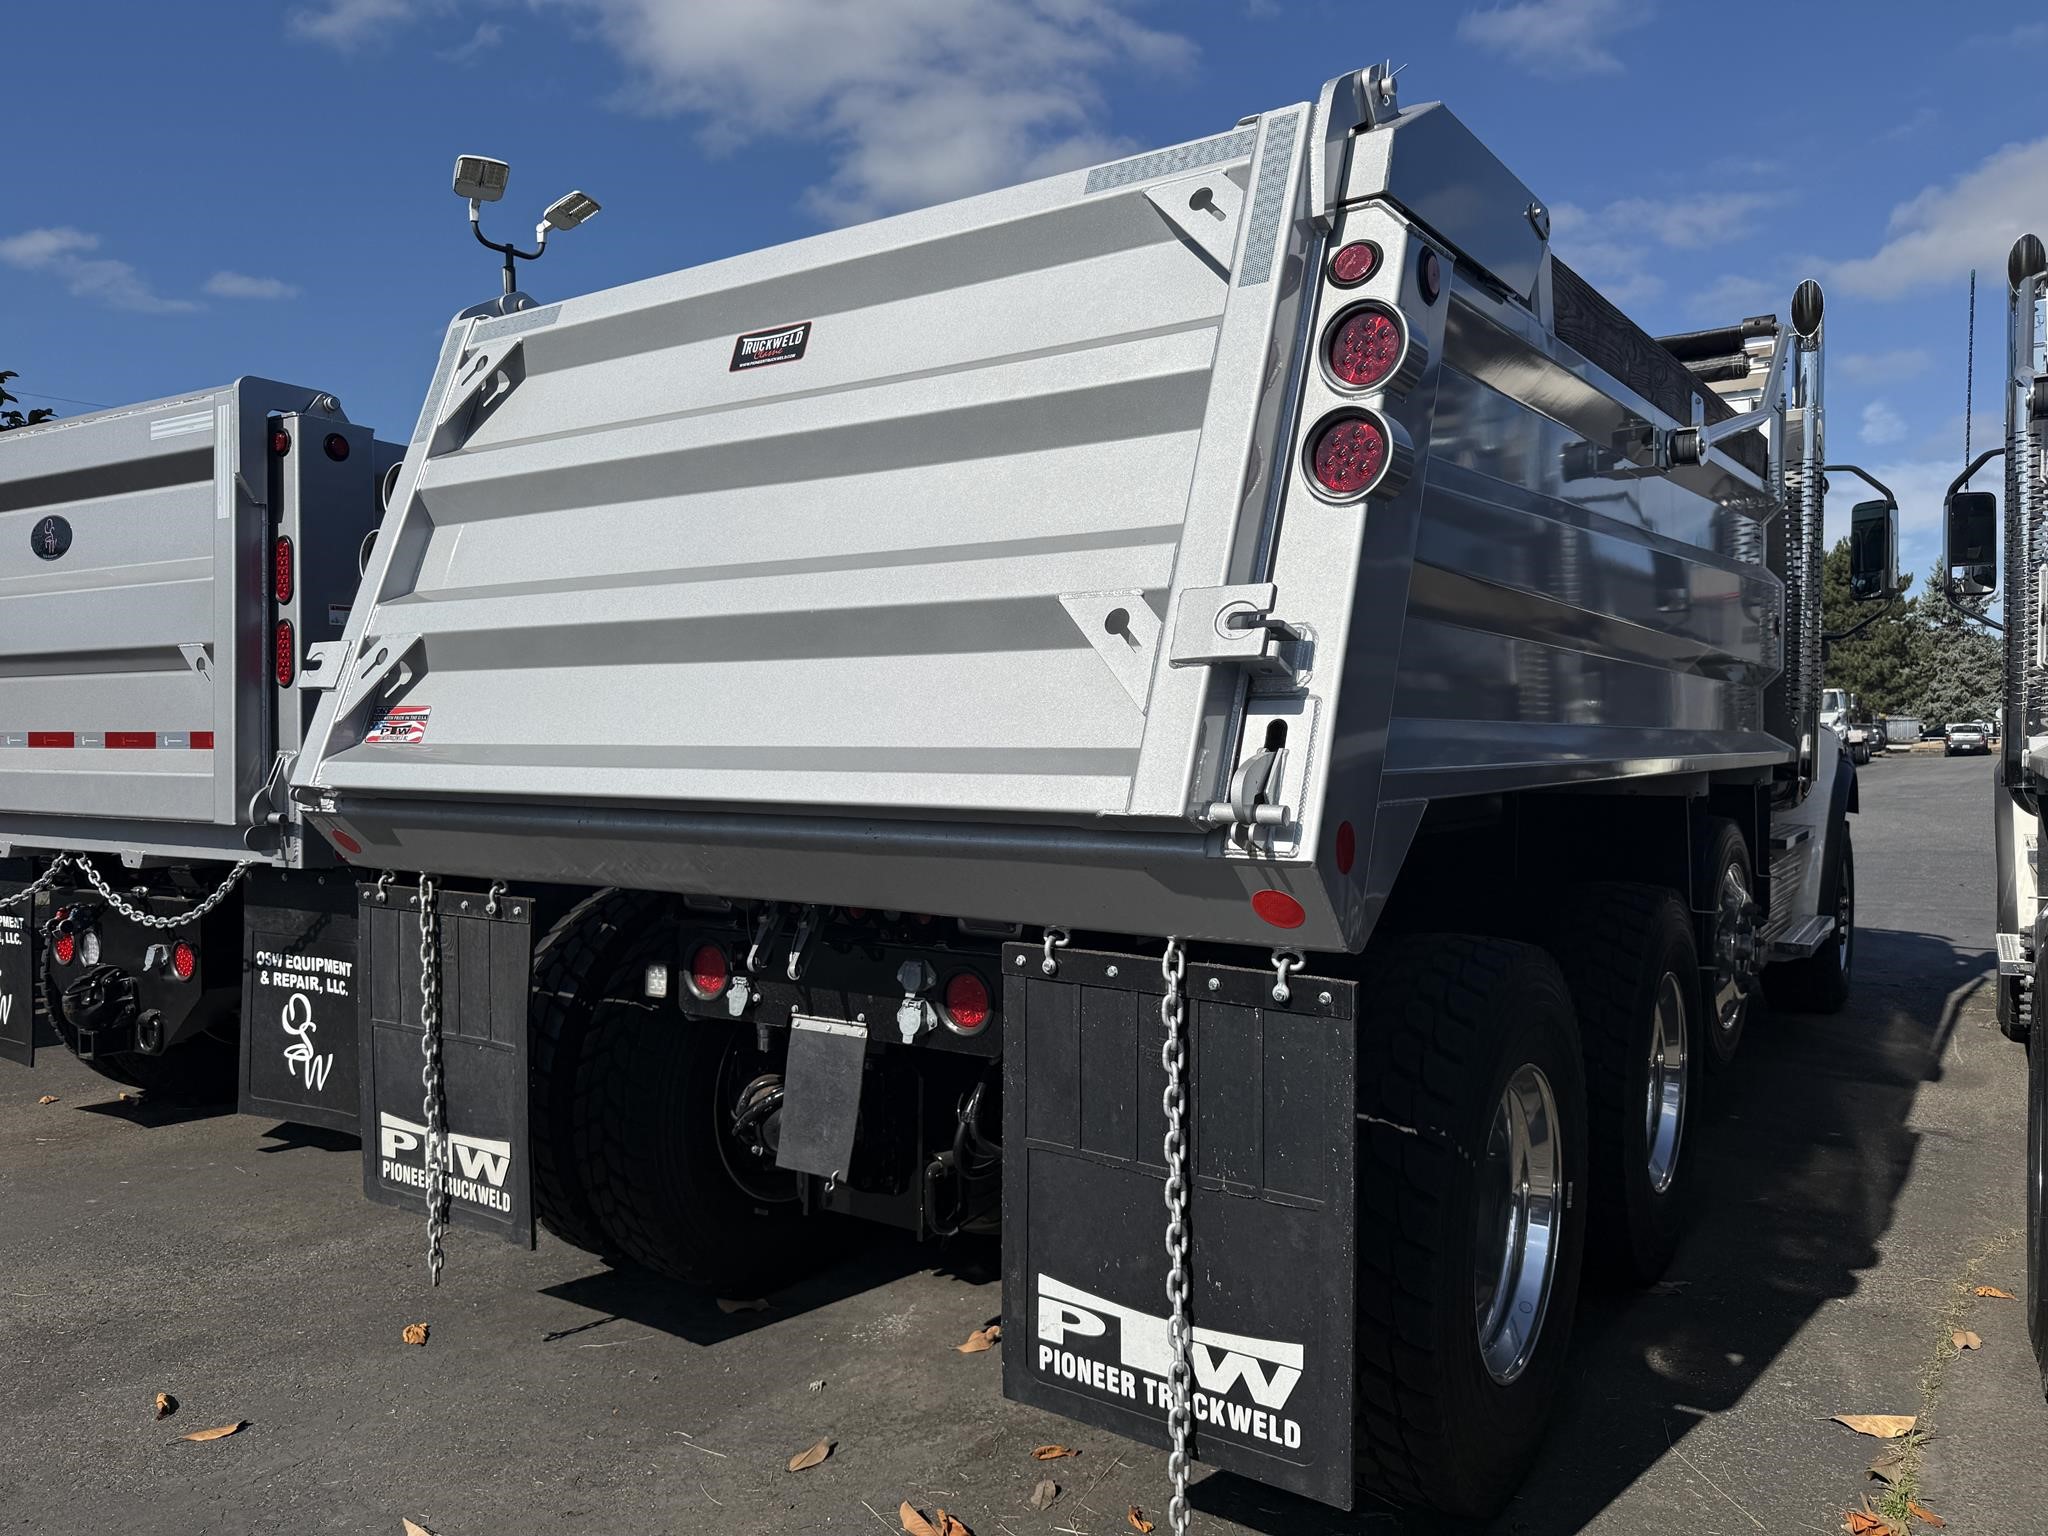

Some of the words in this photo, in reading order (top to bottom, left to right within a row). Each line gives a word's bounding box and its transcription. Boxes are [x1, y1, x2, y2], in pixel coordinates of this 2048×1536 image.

[741, 326, 805, 356] TRUCKWELD
[256, 951, 283, 968] OSW
[285, 954, 353, 978] EQUIPMENT
[260, 970, 270, 985] &
[273, 972, 323, 994] REPAIR,
[326, 978, 349, 997] LLC.
[1038, 1272, 1304, 1410] PTW
[1038, 1344, 1137, 1400] PIONEER
[1142, 1377, 1302, 1449] TRCKWELD
